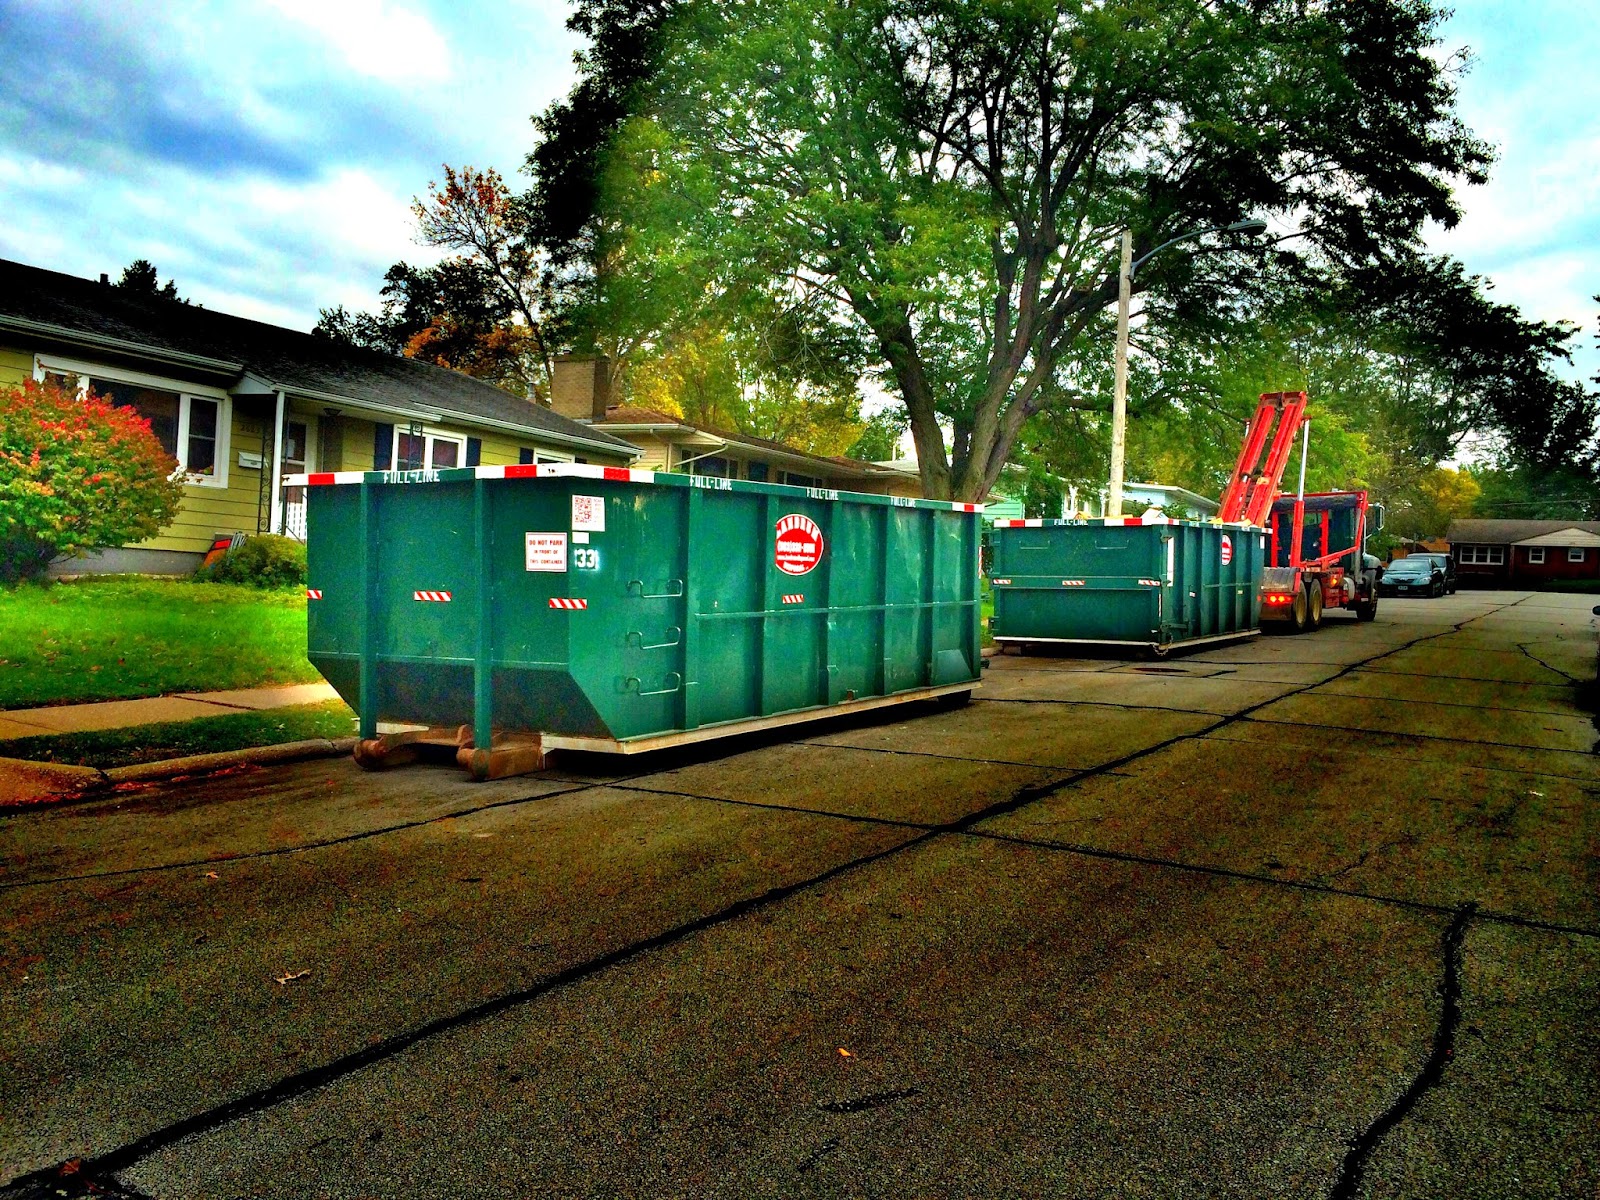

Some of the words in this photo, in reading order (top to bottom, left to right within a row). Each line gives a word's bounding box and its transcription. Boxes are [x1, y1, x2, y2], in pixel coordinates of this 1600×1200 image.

[690, 475, 732, 491] FULL-LINE
[806, 487, 839, 500] FULL-LINE
[577, 548, 595, 568] 33
